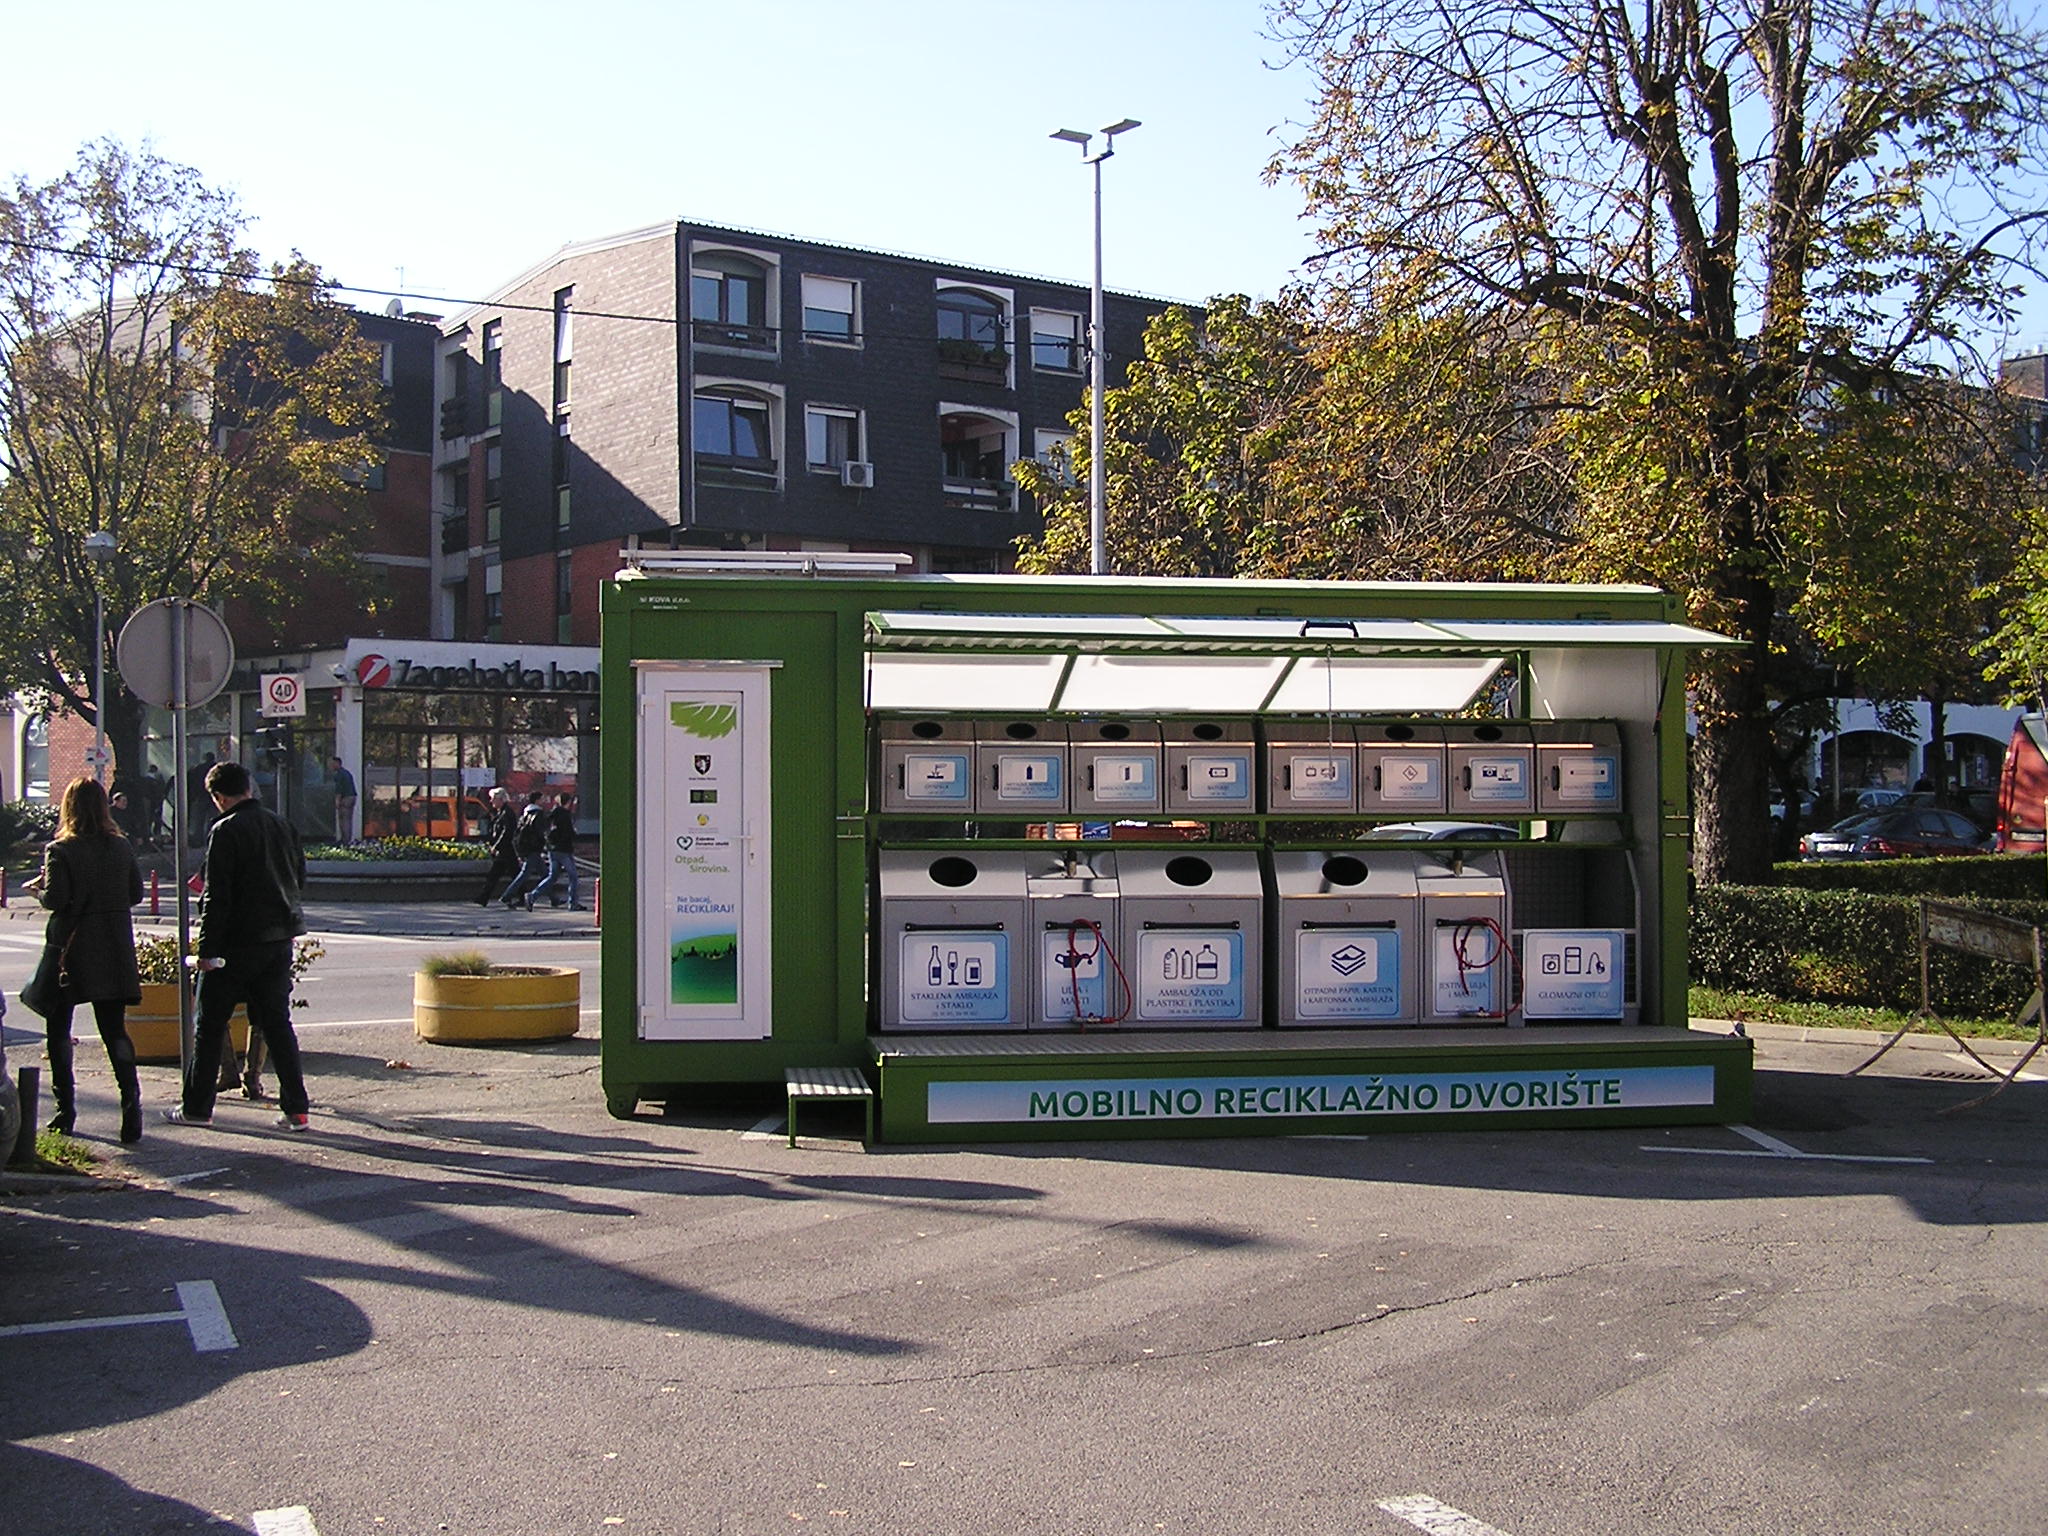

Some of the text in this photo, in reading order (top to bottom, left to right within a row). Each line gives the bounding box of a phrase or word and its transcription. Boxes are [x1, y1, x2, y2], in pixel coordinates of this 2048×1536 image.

[549, 660, 601, 690] ban
[274, 683, 292, 697] 40
[272, 705, 297, 713] ZONA
[677, 904, 735, 913] RECIKLIRAJ!
[911, 992, 952, 1000] STAKLENA
[940, 1001, 974, 1009] STAKLO
[1028, 1071, 1622, 1118] MOBILNO RECIKLAŽNO DVORIŠTE
